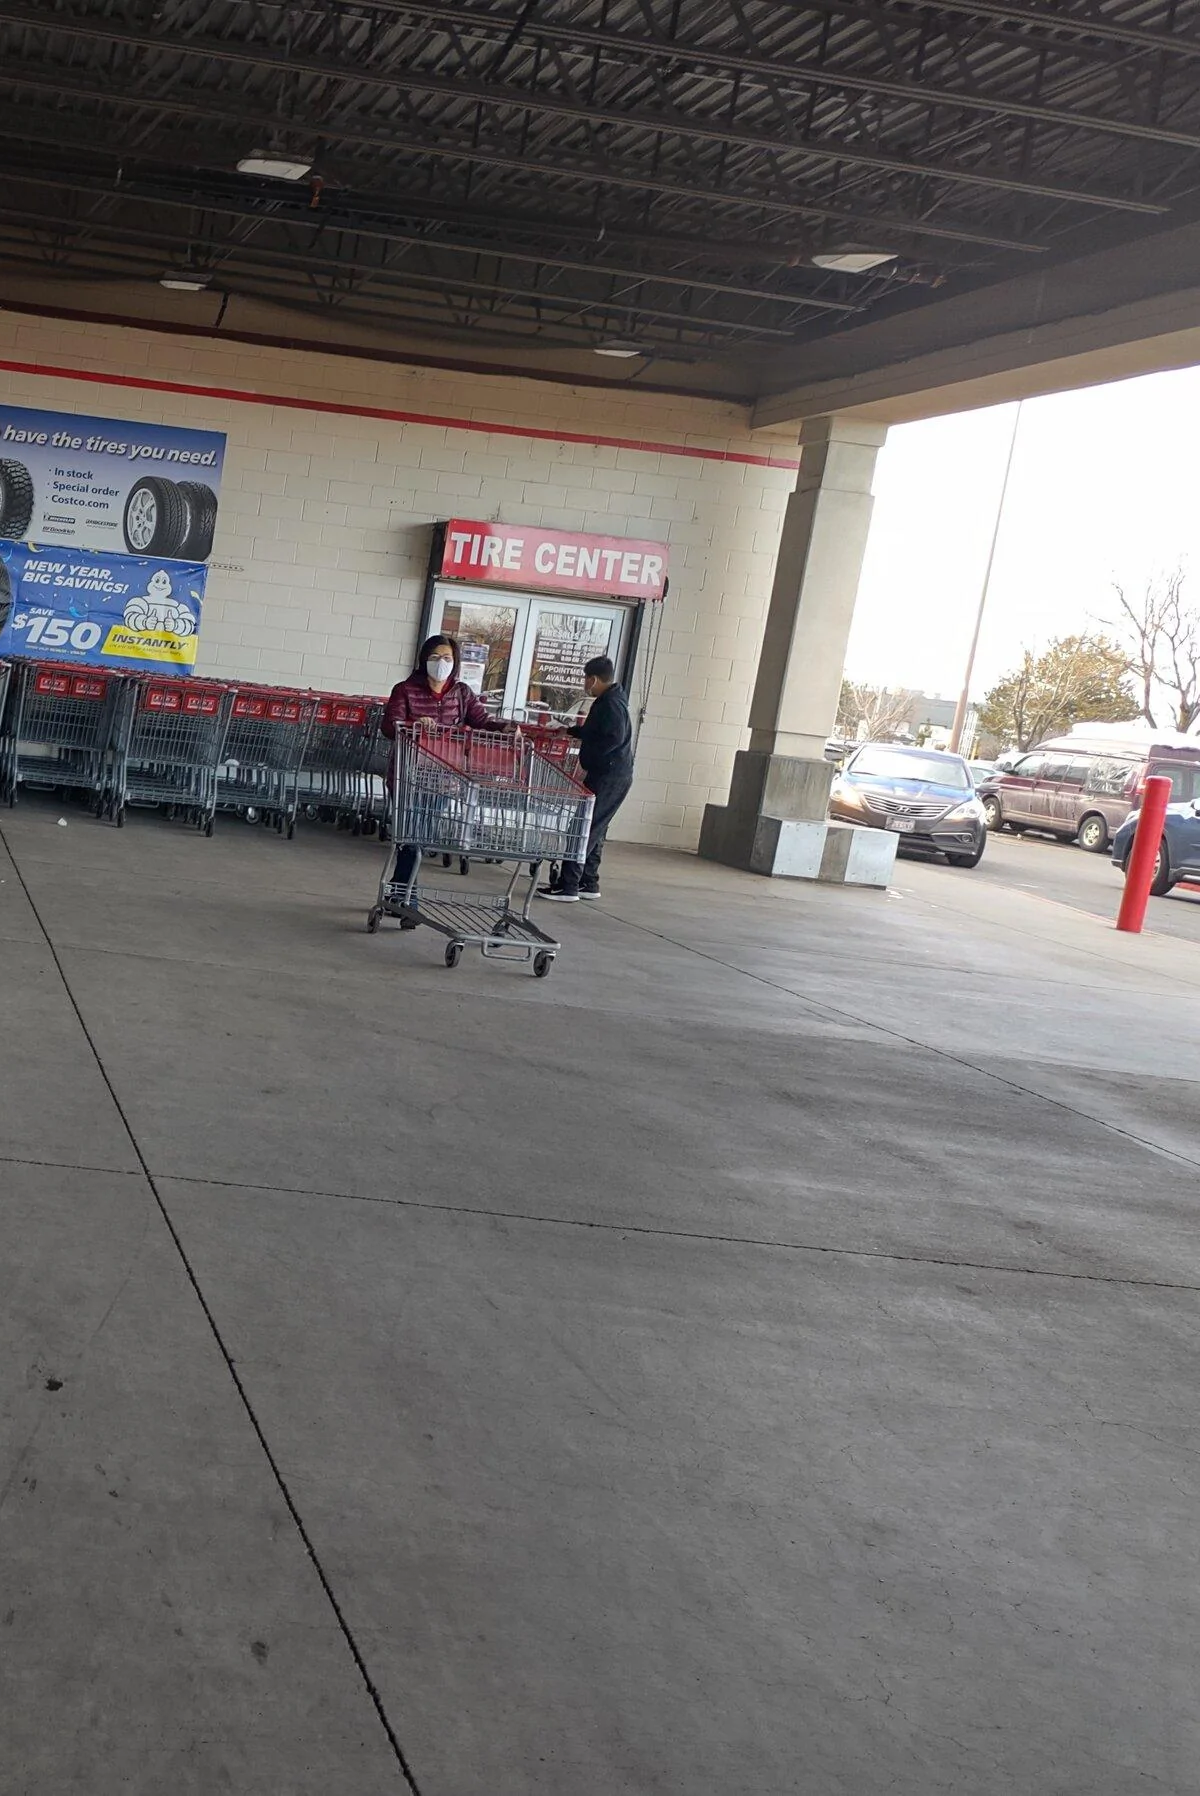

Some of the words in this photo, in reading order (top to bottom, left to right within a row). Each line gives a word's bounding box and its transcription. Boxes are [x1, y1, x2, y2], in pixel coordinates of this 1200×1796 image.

[3, 424, 48, 446] have
[51, 431, 82, 450] the
[86, 436, 128, 455] tires
[128, 444, 166, 461] you
[167, 450, 217, 466] need.
[54, 467, 65, 476] In
[66, 470, 94, 480] stock
[52, 481, 89, 493] Special
[91, 487, 120, 497] order
[51, 494, 109, 509] Costco.com
[450, 531, 525, 571] TIRE
[534, 542, 664, 587] CENTER
[23, 559, 66, 574] NEW
[69, 564, 114, 581] YEAR,
[22, 572, 52, 585] BIG
[53, 575, 130, 594] SAVINGS!
[29, 607, 55, 616] SAVE
[11, 613, 102, 650] $150
[112, 634, 187, 650] INSTANTLY
[538, 664, 586, 676] APPOINTMEN
[545, 674, 586, 684] AVAILABLE
